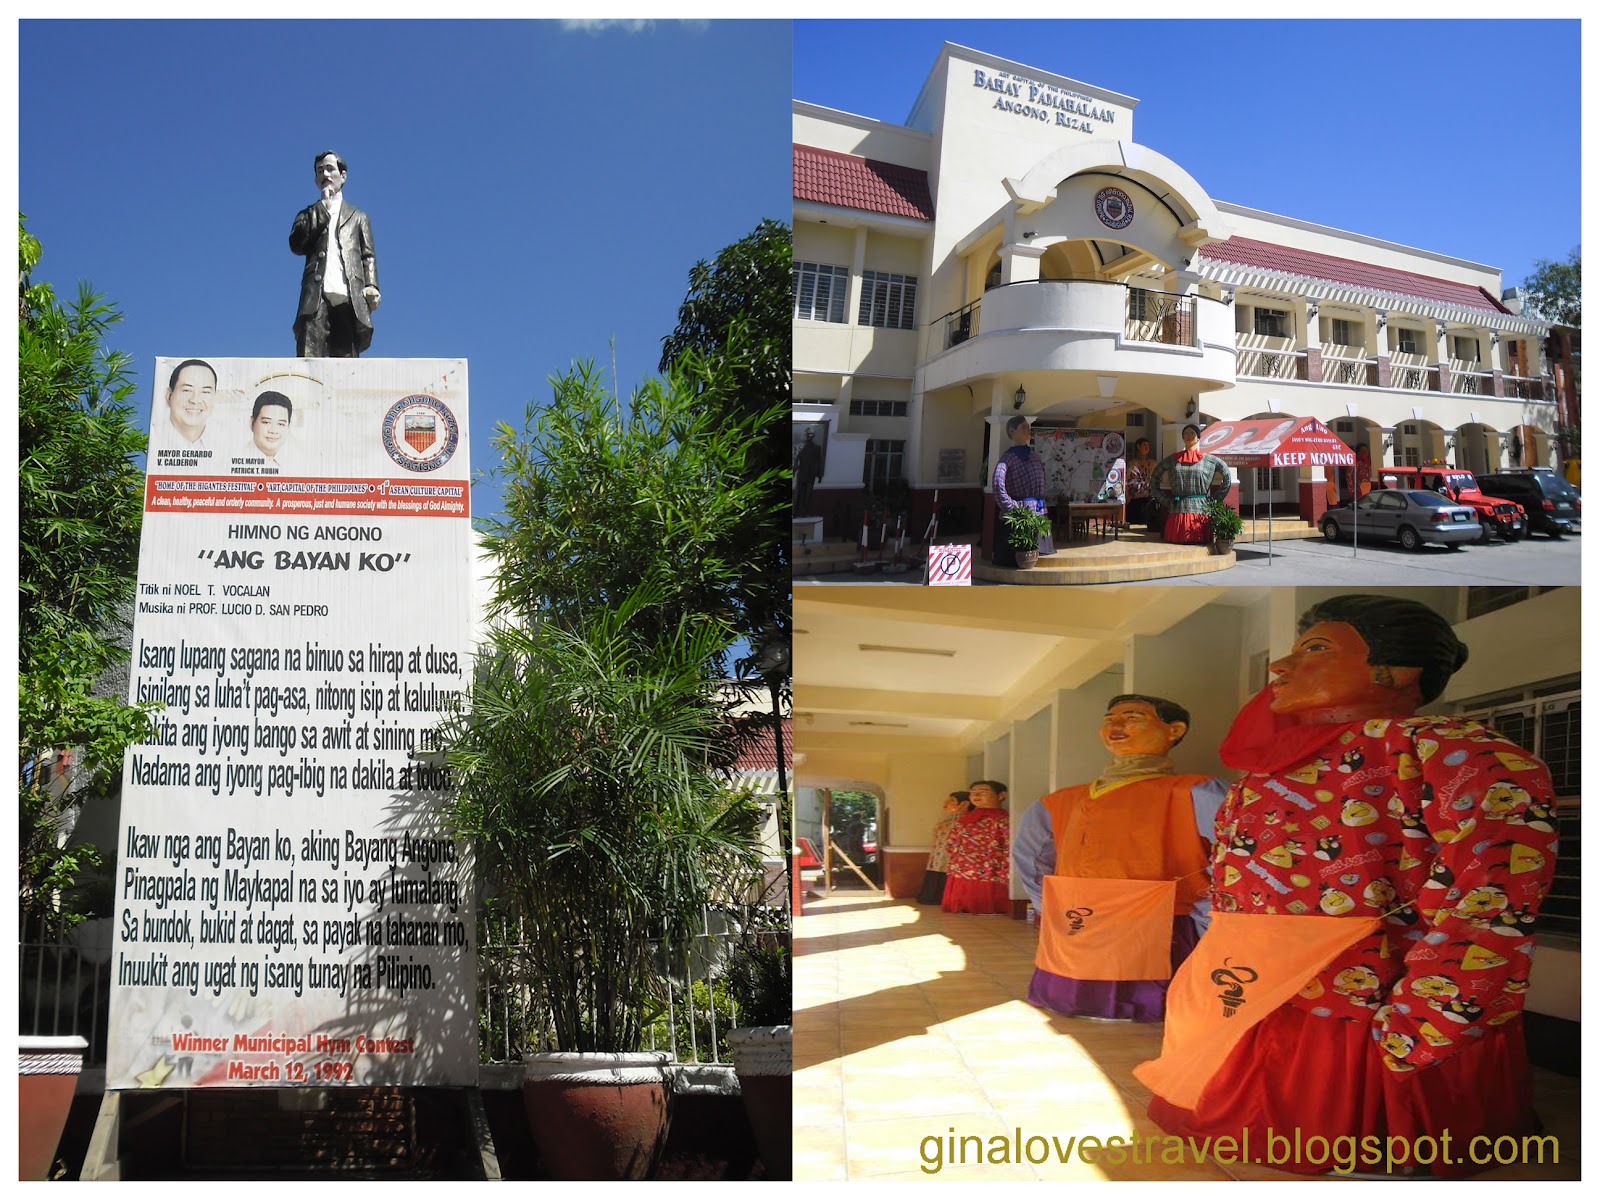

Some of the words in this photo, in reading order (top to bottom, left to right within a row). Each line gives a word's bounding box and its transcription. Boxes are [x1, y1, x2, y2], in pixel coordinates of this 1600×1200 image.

[973, 69, 1022, 98] BAHAY
[1028, 85, 1115, 124] PAMAHALAAN
[993, 96, 1050, 124] ANGONO,
[1055, 111, 1094, 134] RIZAL
[157, 450, 180, 458] MAYOR
[182, 450, 212, 458] GERARDO
[164, 459, 198, 467] CALDERON
[1274, 452, 1306, 466] KEEP
[1310, 452, 1354, 465] MOVING
[176, 482, 184, 491] OF
[185, 482, 197, 491] THE
[198, 482, 226, 491] HIGANTES
[281, 483, 305, 493] CAPITAL
[306, 484, 314, 492] OF
[316, 484, 326, 492] THE
[390, 487, 409, 495] ASEAN
[410, 487, 436, 496] CULTURE
[152, 496, 157, 506] A
[157, 497, 172, 507] clean,
[172, 496, 192, 508] healthy,
[192, 497, 214, 508] peaceful
[215, 497, 225, 507] and
[226, 497, 244, 509] orderly
[245, 498, 274, 509] community.
[276, 498, 281, 507] A
[282, 499, 312, 510] prosperous,
[313, 499, 324, 510] just
[325, 499, 334, 509] and
[336, 499, 356, 509] humane
[357, 500, 375, 511] society
[376, 500, 387, 509] with
[388, 500, 396, 509] the
[397, 500, 422, 512] blessings
[423, 501, 429, 510] of
[430, 501, 440, 510] God
[441, 501, 464, 513] Almighty.
[228, 525, 282, 540] HIMNO
[286, 525, 310, 541] NG
[314, 526, 383, 542] ANGONO
[273, 550, 352, 571] BAYAN
[140, 583, 160, 596] Titik
[162, 583, 172, 596] ni
[174, 584, 201, 596] NOEL
[207, 585, 216, 596] T.
[222, 585, 270, 598] VOCALAN
[139, 602, 174, 615] Musika
[176, 603, 186, 615] ni
[189, 603, 218, 615] PROF.
[222, 603, 252, 615] LUCIO
[255, 604, 266, 616] D.
[270, 604, 290, 616] SAN
[294, 605, 329, 617] PEDRO
[139, 638, 175, 677] Isang
[180, 639, 226, 677] lupang
[230, 647, 280, 678] sagana
[284, 648, 300, 671] na
[306, 642, 344, 672] binuo
[348, 649, 364, 673] sa
[369, 642, 404, 682] hirap
[408, 646, 422, 673] at
[425, 644, 462, 680] dusa,
[137, 676, 190, 715] Isinilang
[194, 685, 210, 708] sa
[214, 678, 250, 709] luha't
[254, 686, 310, 717] pag-asa,
[316, 680, 355, 719] nitong
[360, 681, 382, 719] isip
[387, 683, 400, 710] at
[182, 723, 207, 755] ang
[212, 717, 249, 756] iyong
[254, 718, 296, 756] bango
[301, 725, 317, 749] sa
[322, 719, 352, 750] awit
[356, 722, 370, 750] at
[373, 720, 415, 759] sining
[131, 754, 190, 786] Nadama
[195, 762, 221, 795] ang
[226, 756, 263, 796] iyong
[268, 758, 325, 797] pag-ibig
[330, 765, 347, 789] na
[352, 758, 395, 791] dakila
[400, 761, 413, 790] at
[127, 826, 160, 859] Ikaw
[164, 834, 190, 868] nga
[195, 835, 222, 868] ang
[226, 828, 270, 869] Bayan
[275, 829, 295, 867] ko,
[301, 829, 340, 870] aking
[345, 830, 398, 871] Bayang
[124, 867, 196, 910] Pinagpala
[201, 877, 219, 910] ng
[224, 868, 294, 911] Maykapal
[299, 880, 317, 903] na
[321, 880, 339, 904] sa
[344, 871, 364, 912] iyo
[369, 881, 386, 912] ay
[391, 871, 462, 913] lumalang.
[121, 908, 138, 942] Sa
[142, 909, 195, 949] bundok,
[200, 910, 236, 944] bukid
[240, 915, 253, 945] at
[257, 911, 298, 954] dagat,
[303, 921, 319, 946] sa
[323, 913, 362, 954] payak
[366, 921, 383, 946] na
[386, 914, 439, 947] tahanan
[444, 922, 469, 952] mo,
[118, 952, 168, 987] Inuukit
[172, 961, 199, 997] ang
[205, 956, 237, 997] ugat
[241, 961, 259, 997] ng
[264, 954, 303, 997] isang
[308, 956, 350, 998] tunay
[354, 965, 372, 989] na
[376, 955, 436, 998] Pilipino.
[172, 1033, 229, 1052] Winner
[233, 1033, 312, 1056] Municipal
[316, 1034, 351, 1055] Hym
[355, 1035, 415, 1054] Contest
[228, 1061, 281, 1081] March
[285, 1062, 309, 1083] 12,
[313, 1062, 354, 1081] 1992
